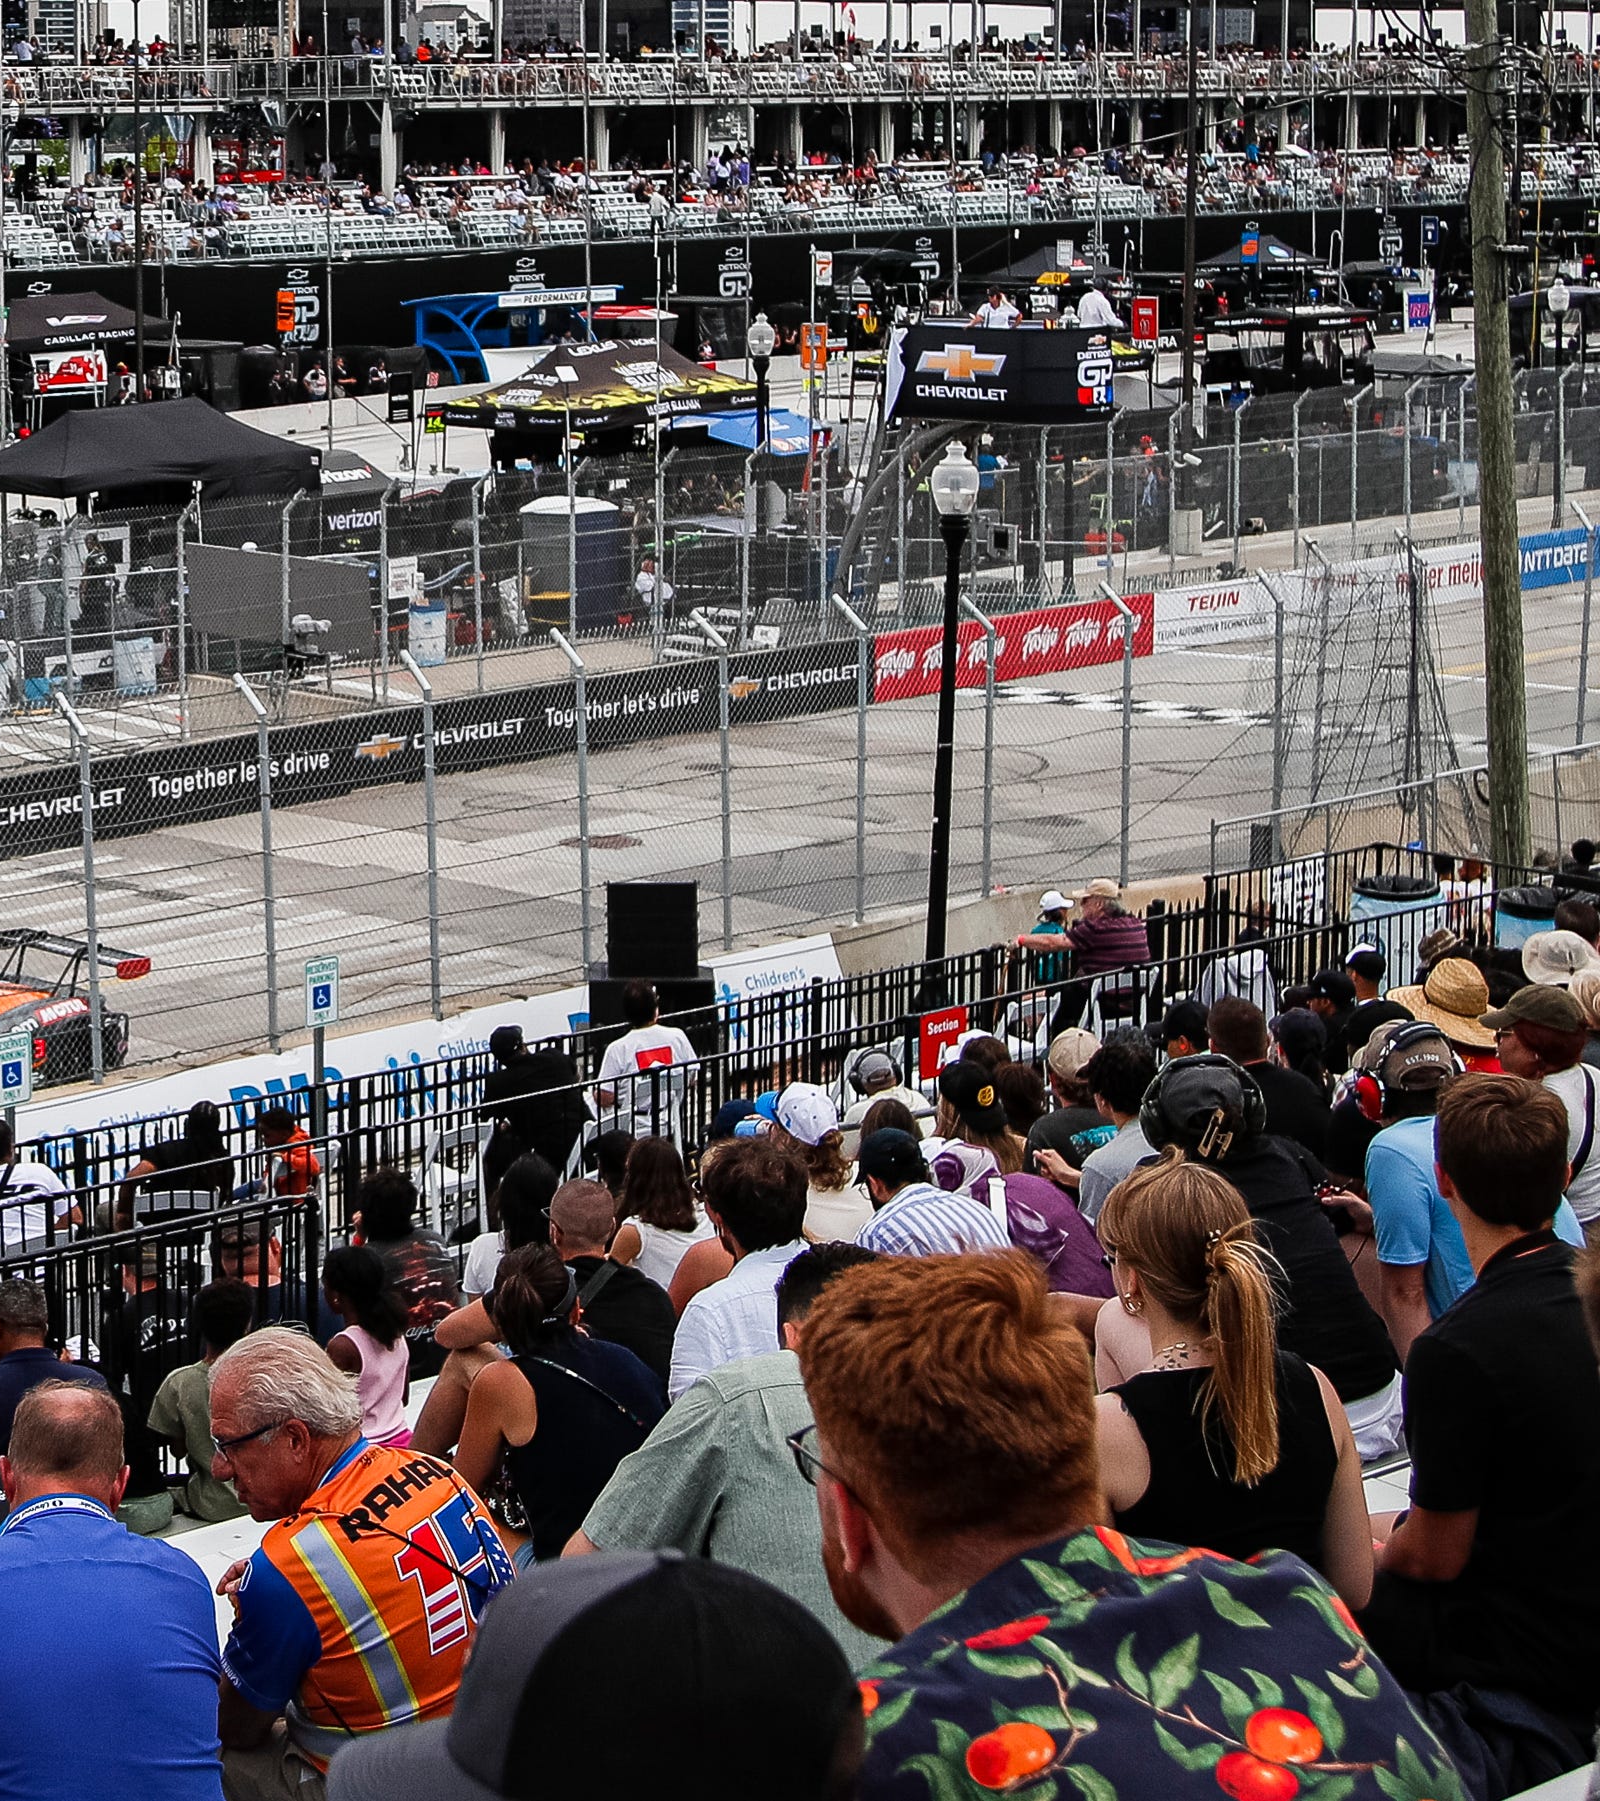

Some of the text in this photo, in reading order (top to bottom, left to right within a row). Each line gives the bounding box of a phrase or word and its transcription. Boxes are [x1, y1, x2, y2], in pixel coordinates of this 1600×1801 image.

[508, 273, 545, 283] DETROIT
[44, 328, 136, 346] CADILLAC RACING
[915, 384, 1008, 402] CHEVROLET
[320, 469, 371, 485] rizon
[327, 508, 383, 531] verizon
[1449, 552, 1486, 588] meij
[1188, 590, 1239, 612] TEIJIN
[767, 663, 861, 693] CHEVROLET
[623, 693, 657, 717] let's
[660, 685, 700, 709] drive
[148, 766, 237, 801] Together
[284, 750, 331, 777] drive
[306, 961, 337, 975] RESERVED
[308, 973, 336, 984] PARKING
[745, 966, 806, 991] Children's
[39, 998, 88, 1024] MOTUL
[314, 1011, 330, 1021] ONLY
[927, 1018, 959, 1036] Section
[438, 1037, 491, 1061] Childre
[4, 1088, 22, 1101] ONLY
[336, 1455, 454, 1543] RAHAL
[393, 1488, 517, 1656] 15
